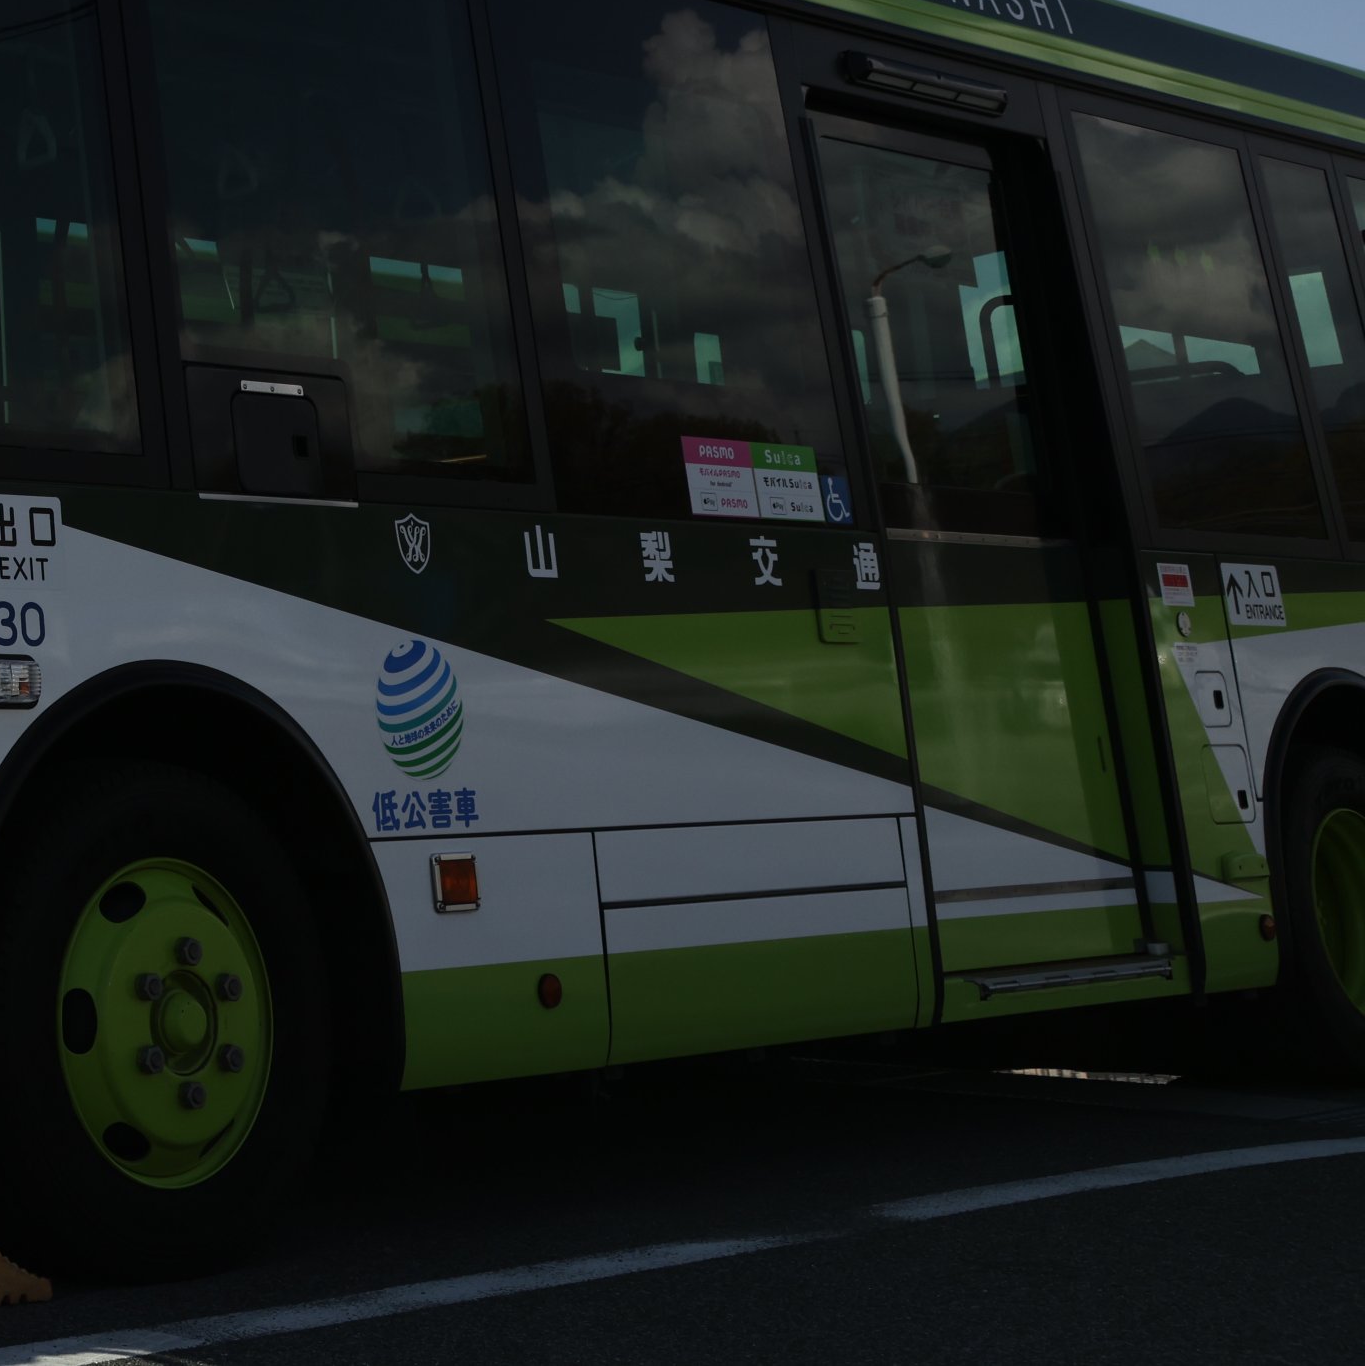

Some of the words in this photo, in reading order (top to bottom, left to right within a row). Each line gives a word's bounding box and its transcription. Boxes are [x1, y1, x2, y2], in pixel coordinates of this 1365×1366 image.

[698, 445, 734, 460] PASMO
[764, 450, 801, 466] Suica
[763, 477, 812, 490] モバイルSuica
[721, 498, 748, 509] PASMO
[790, 502, 813, 513] Suica
[523, 524, 881, 591] 山梨交通
[0, 557, 48, 581] EXIT
[1245, 570, 1275, 598] 入口
[1245, 604, 1284, 620] ENTRANCE
[391, 700, 458, 746] 人と地球の未来のために
[372, 787, 479, 832] 低公害車
